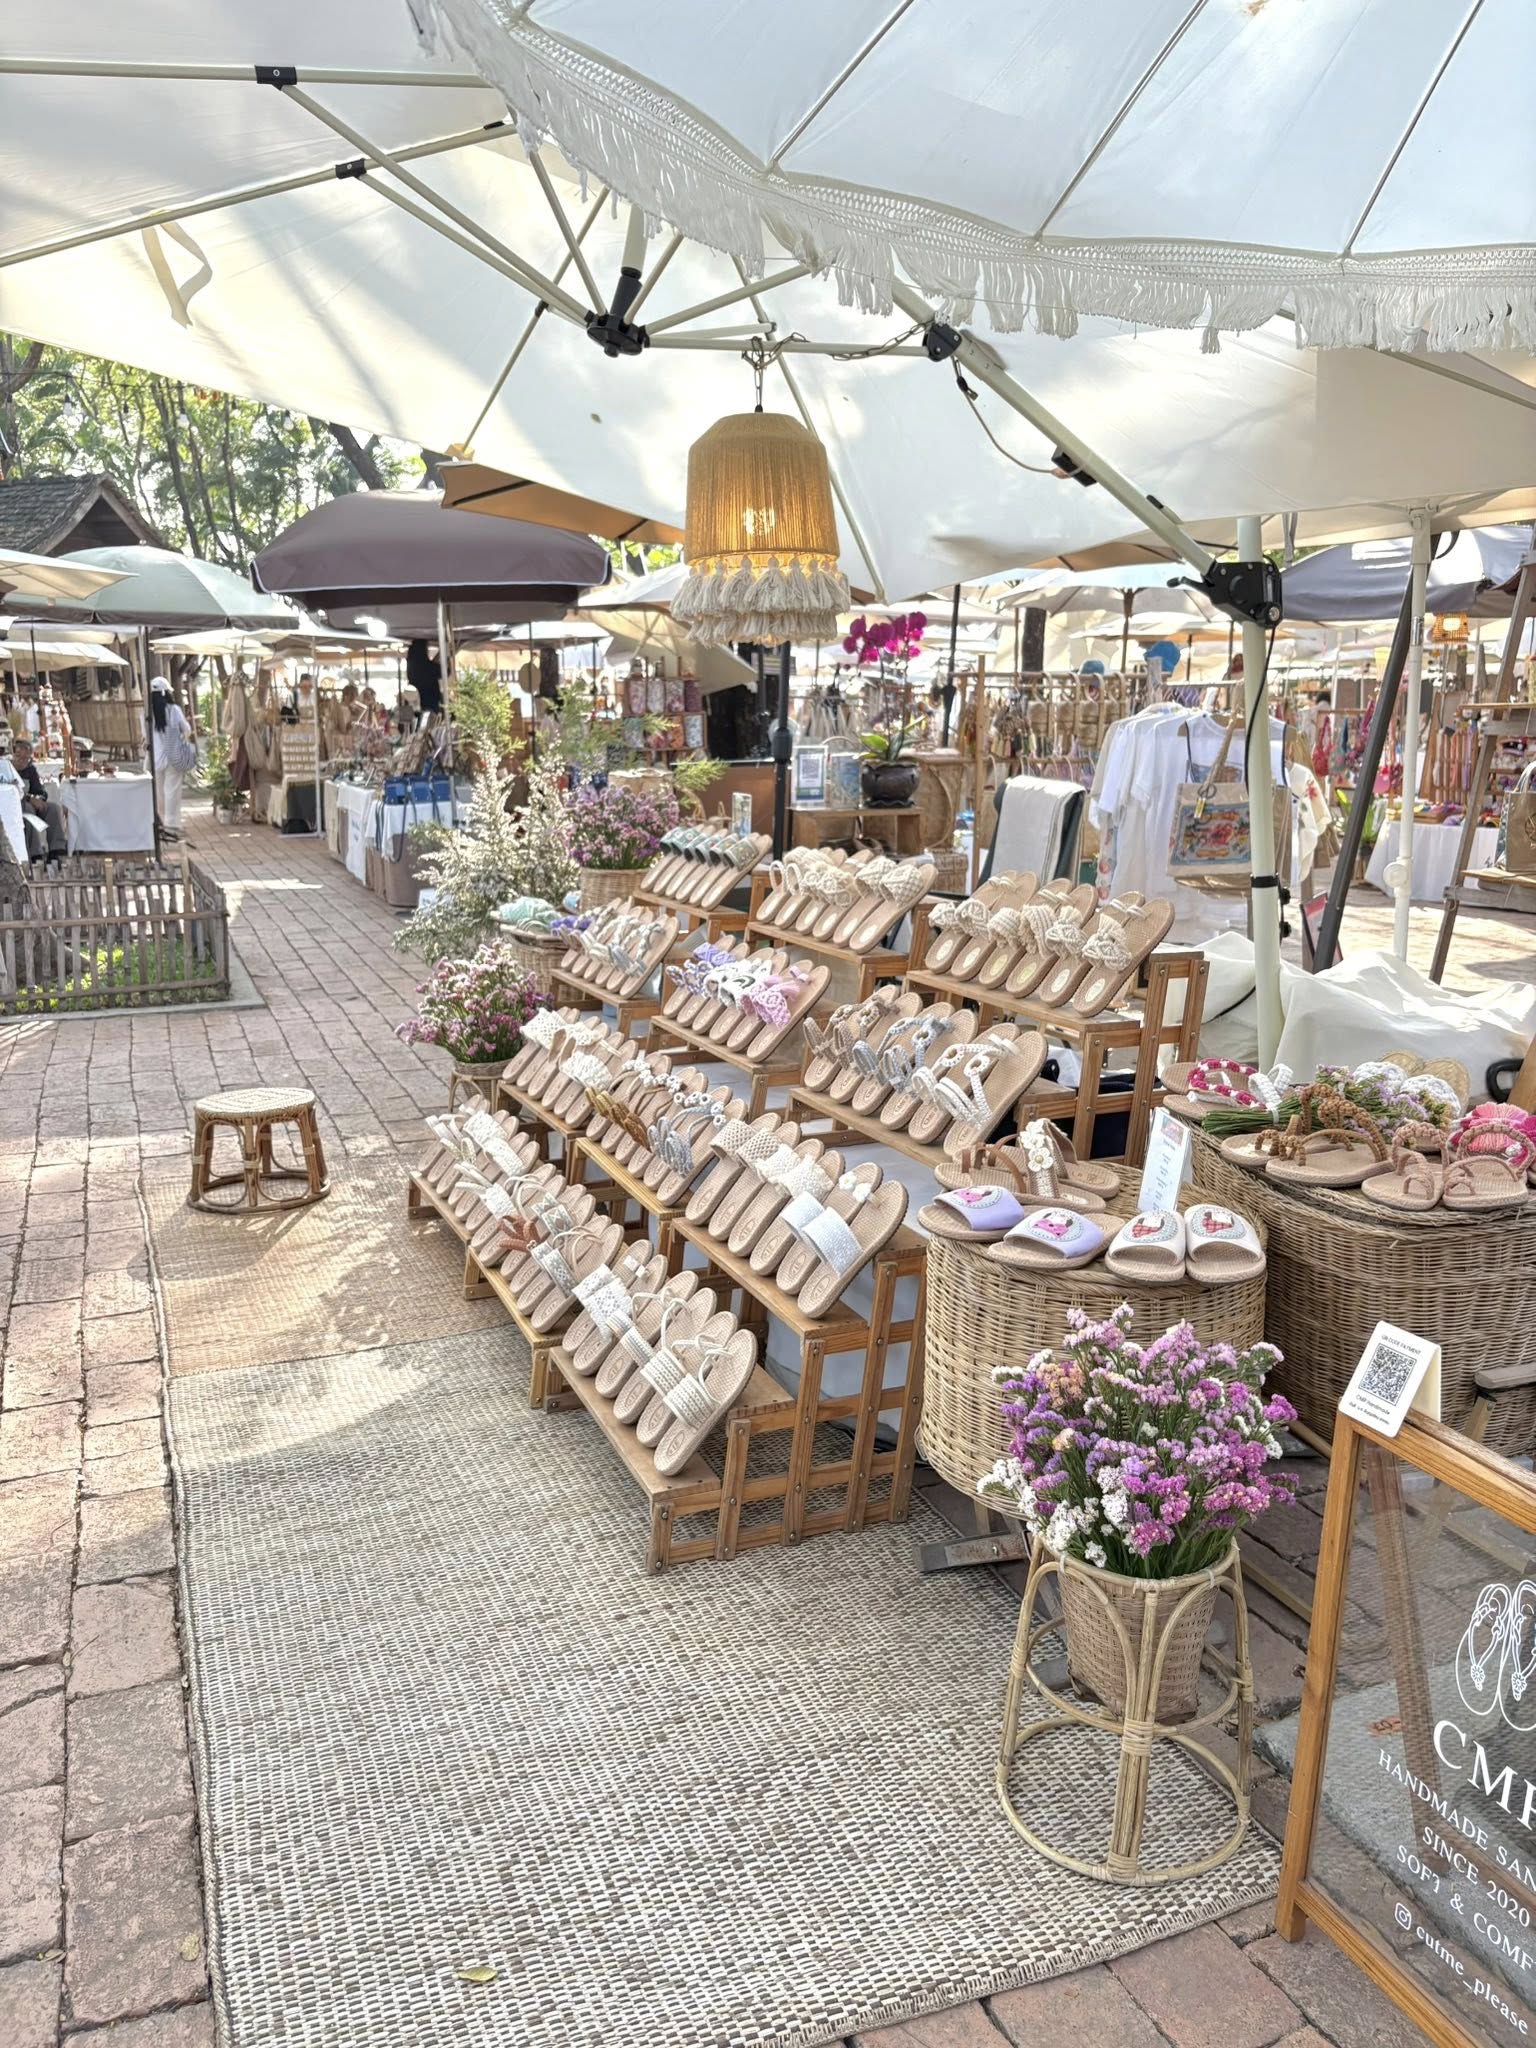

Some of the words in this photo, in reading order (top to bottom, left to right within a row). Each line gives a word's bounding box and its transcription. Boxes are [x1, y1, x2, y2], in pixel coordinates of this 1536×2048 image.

[1378, 1748, 1489, 1851] HANDMADE
[1422, 1826, 1479, 1885] SINCE
[1486, 1880, 1530, 1928] 2020
[1416, 1926, 1528, 2035] cutme_please
[1449, 1893, 1465, 1915] &
[1473, 1912, 1536, 1971] COMF
